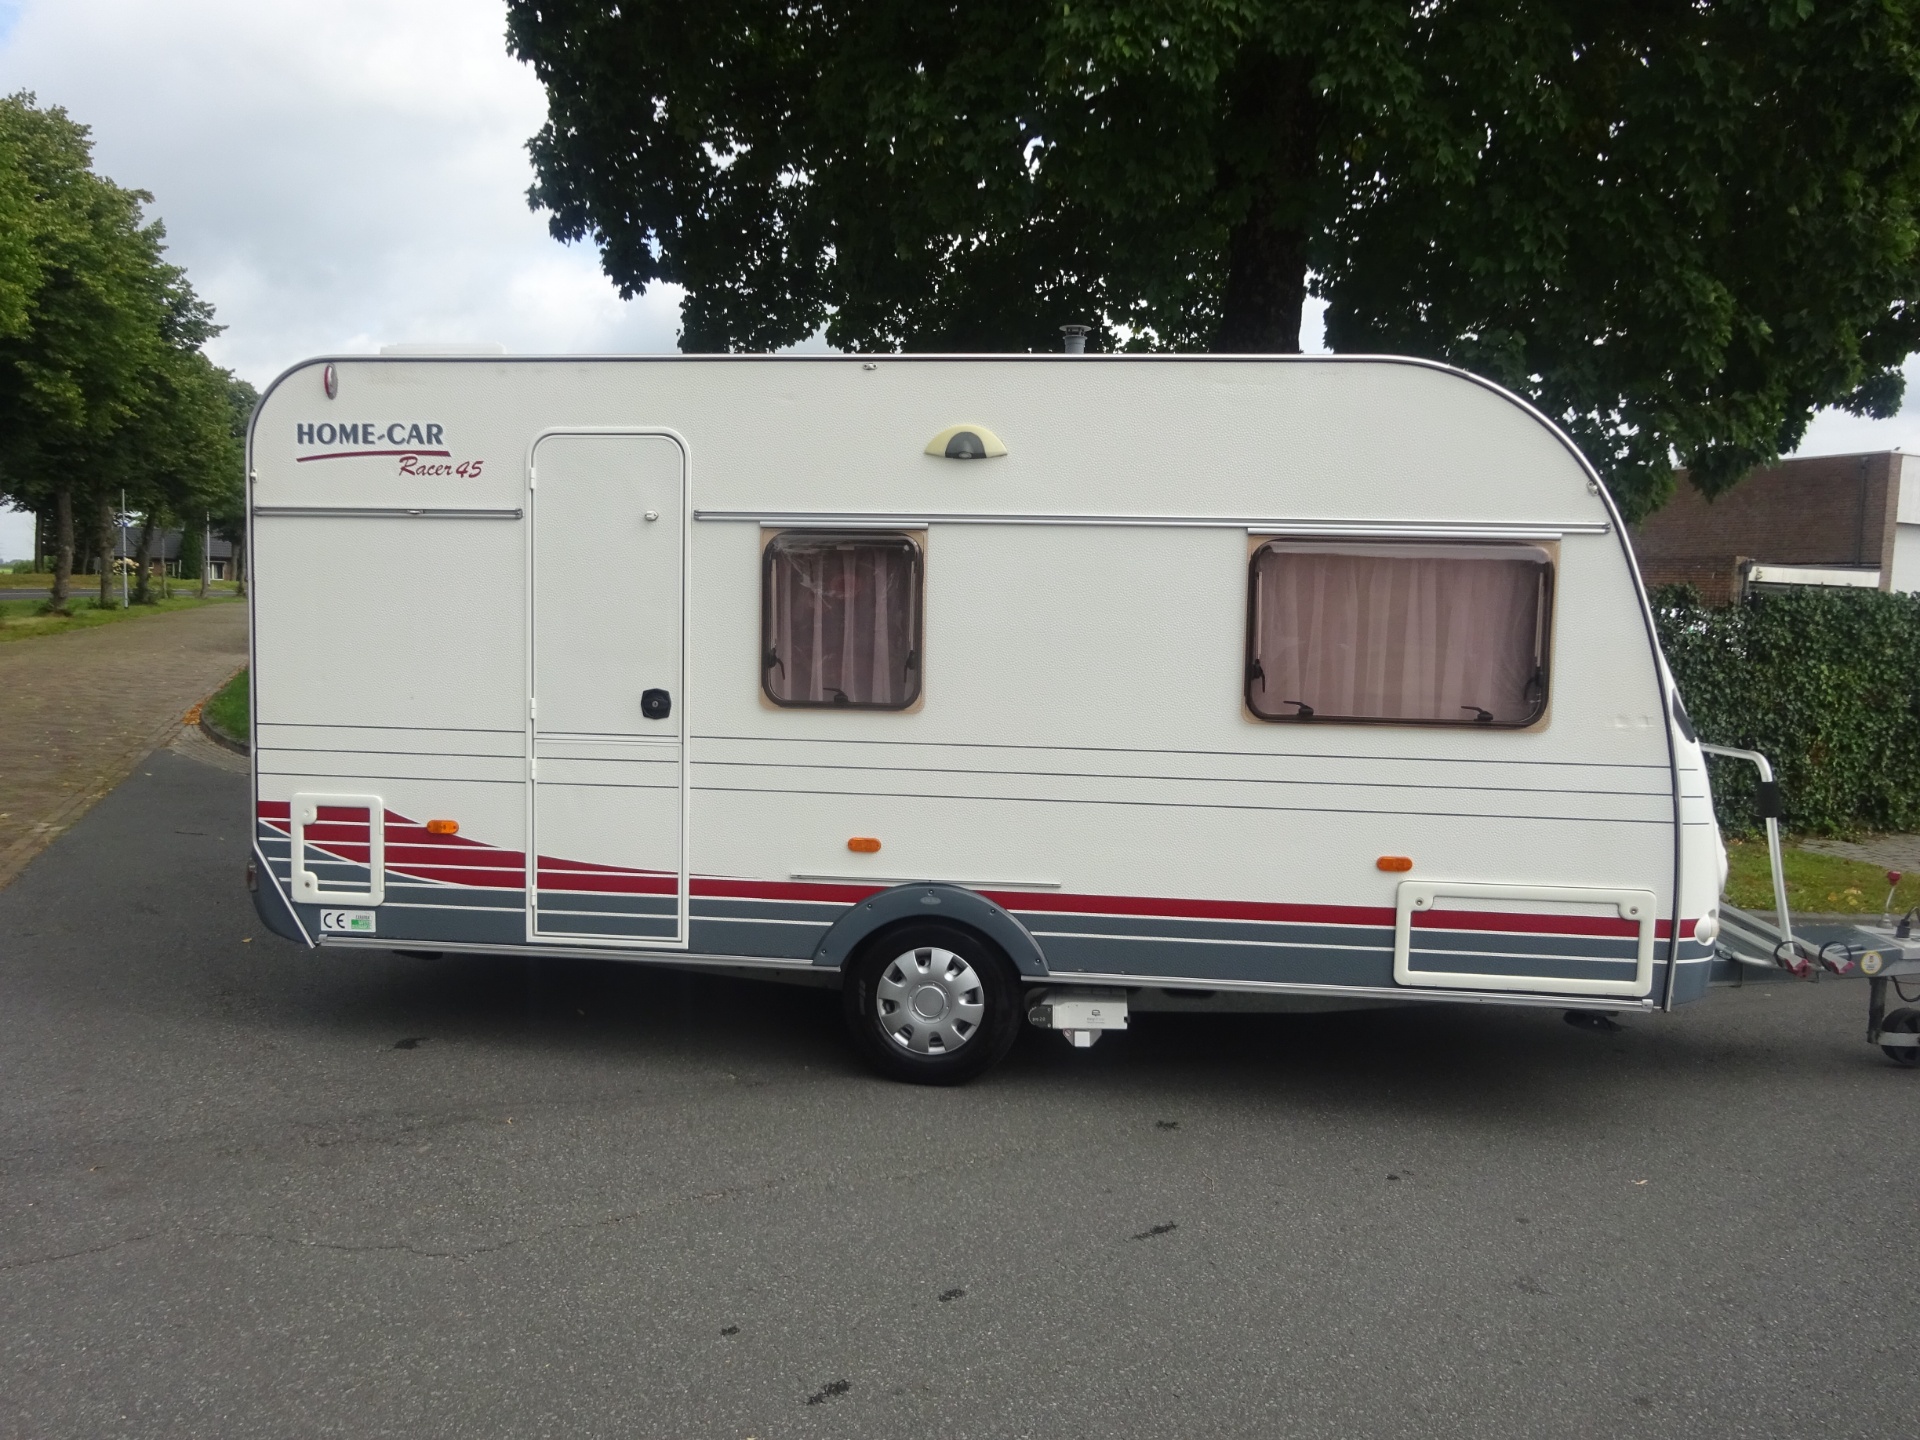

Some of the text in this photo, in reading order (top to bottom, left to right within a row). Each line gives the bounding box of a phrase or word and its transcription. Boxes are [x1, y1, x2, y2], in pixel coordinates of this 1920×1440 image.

[296, 423, 444, 445] HOME-CAR
[398, 455, 484, 479] Racer 45
